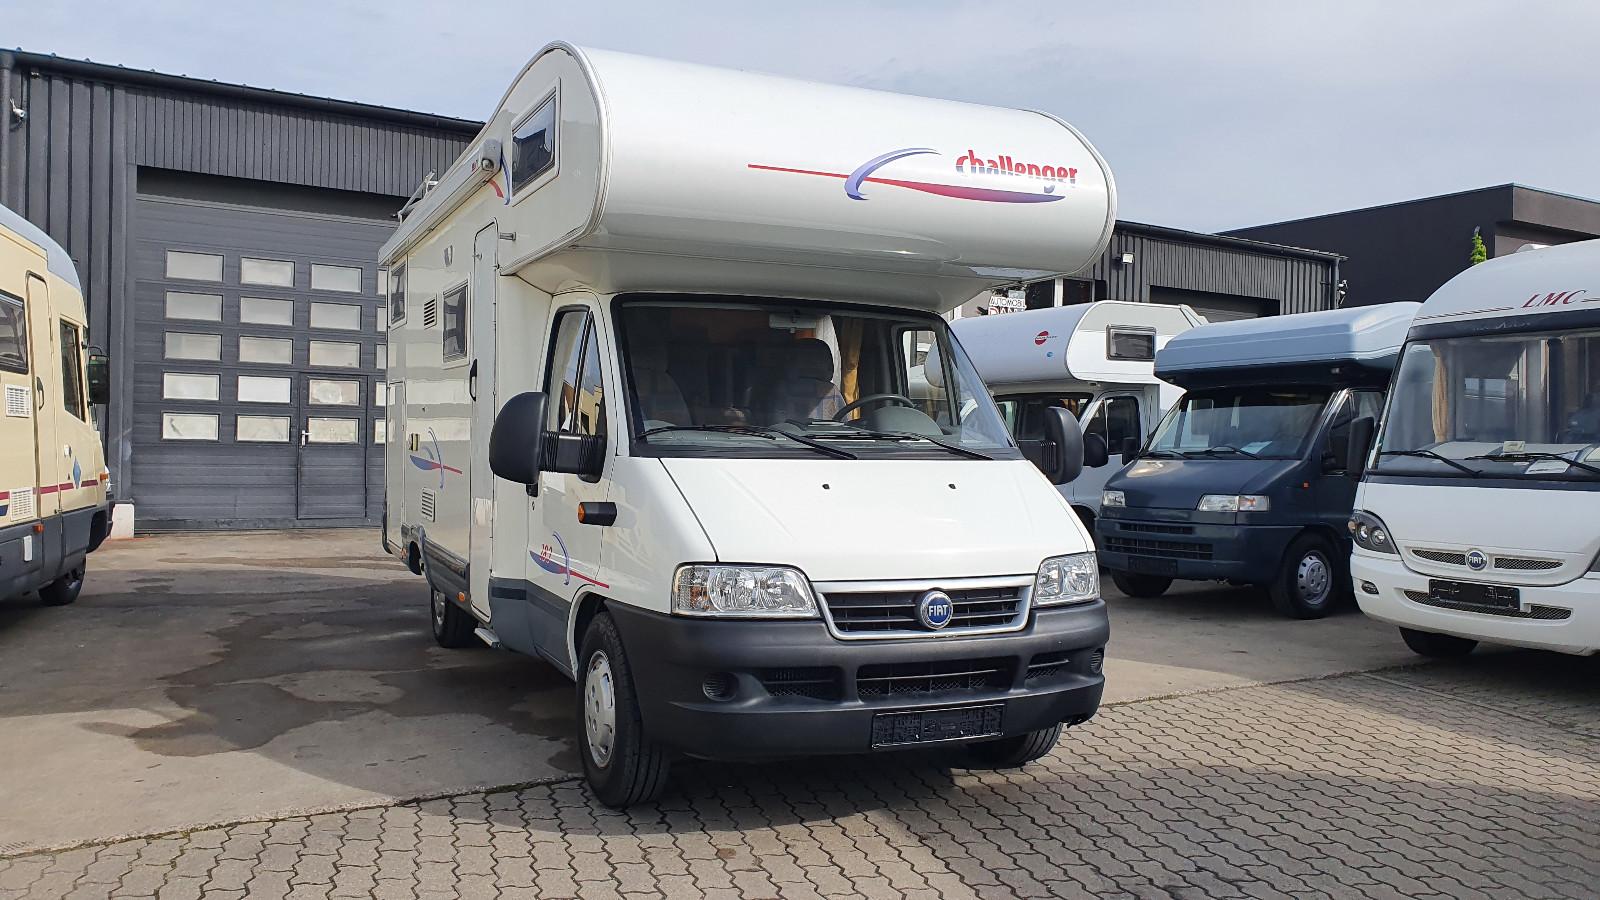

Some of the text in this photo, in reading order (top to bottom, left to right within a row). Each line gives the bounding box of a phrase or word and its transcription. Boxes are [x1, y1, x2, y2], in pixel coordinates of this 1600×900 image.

[955, 149, 1078, 194] challenger
[1520, 289, 1587, 309] LMC
[1468, 555, 1483, 564] FIAT
[928, 604, 949, 617] FIAT
